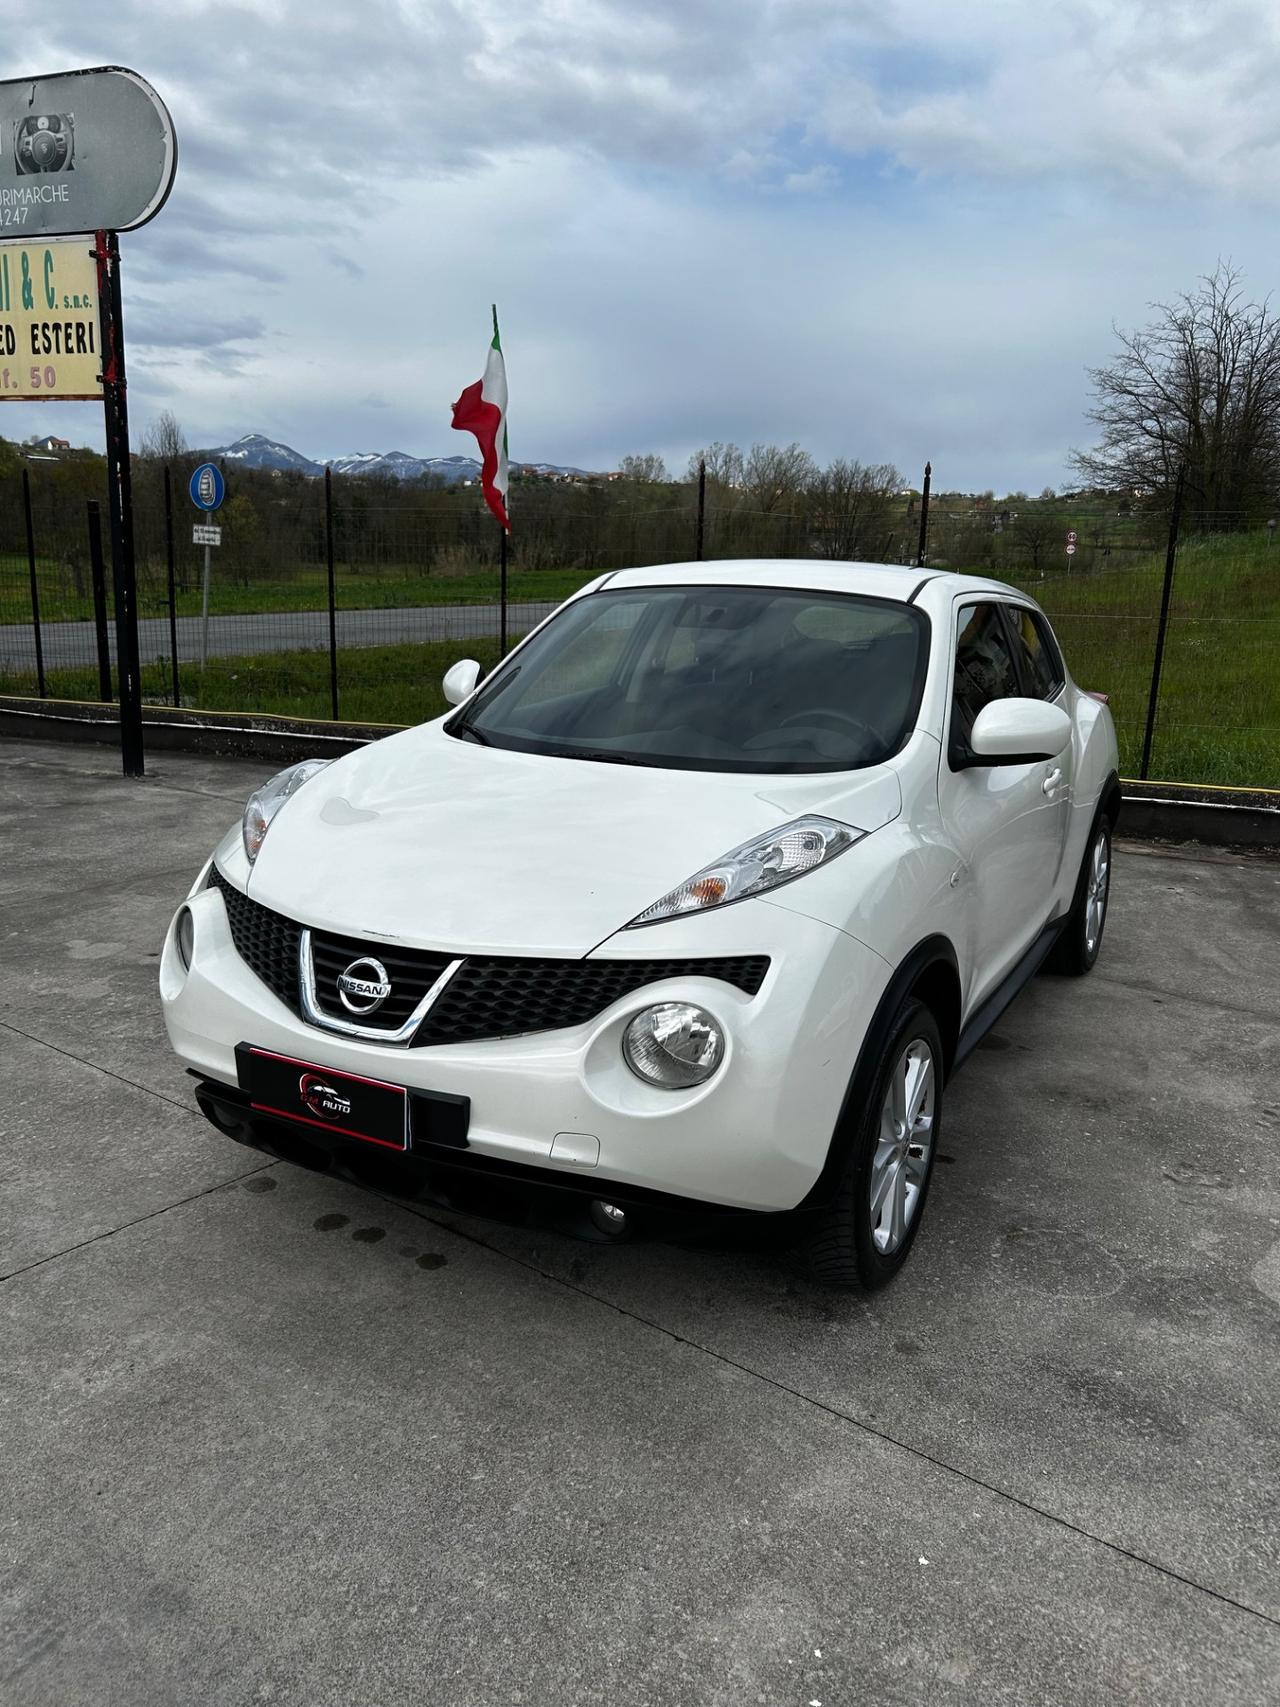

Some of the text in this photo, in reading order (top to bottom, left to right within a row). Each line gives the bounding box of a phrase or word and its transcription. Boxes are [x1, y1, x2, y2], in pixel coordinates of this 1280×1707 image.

[0, 184, 69, 206] RIMARCHE
[21, 251, 34, 310] &
[44, 249, 58, 310] C.
[64, 294, 92, 309] s.n.c.
[31, 322, 95, 355] ESTERI
[30, 366, 56, 389] 50
[339, 976, 383, 995] NISSAN
[322, 1100, 351, 1114] AUTO
